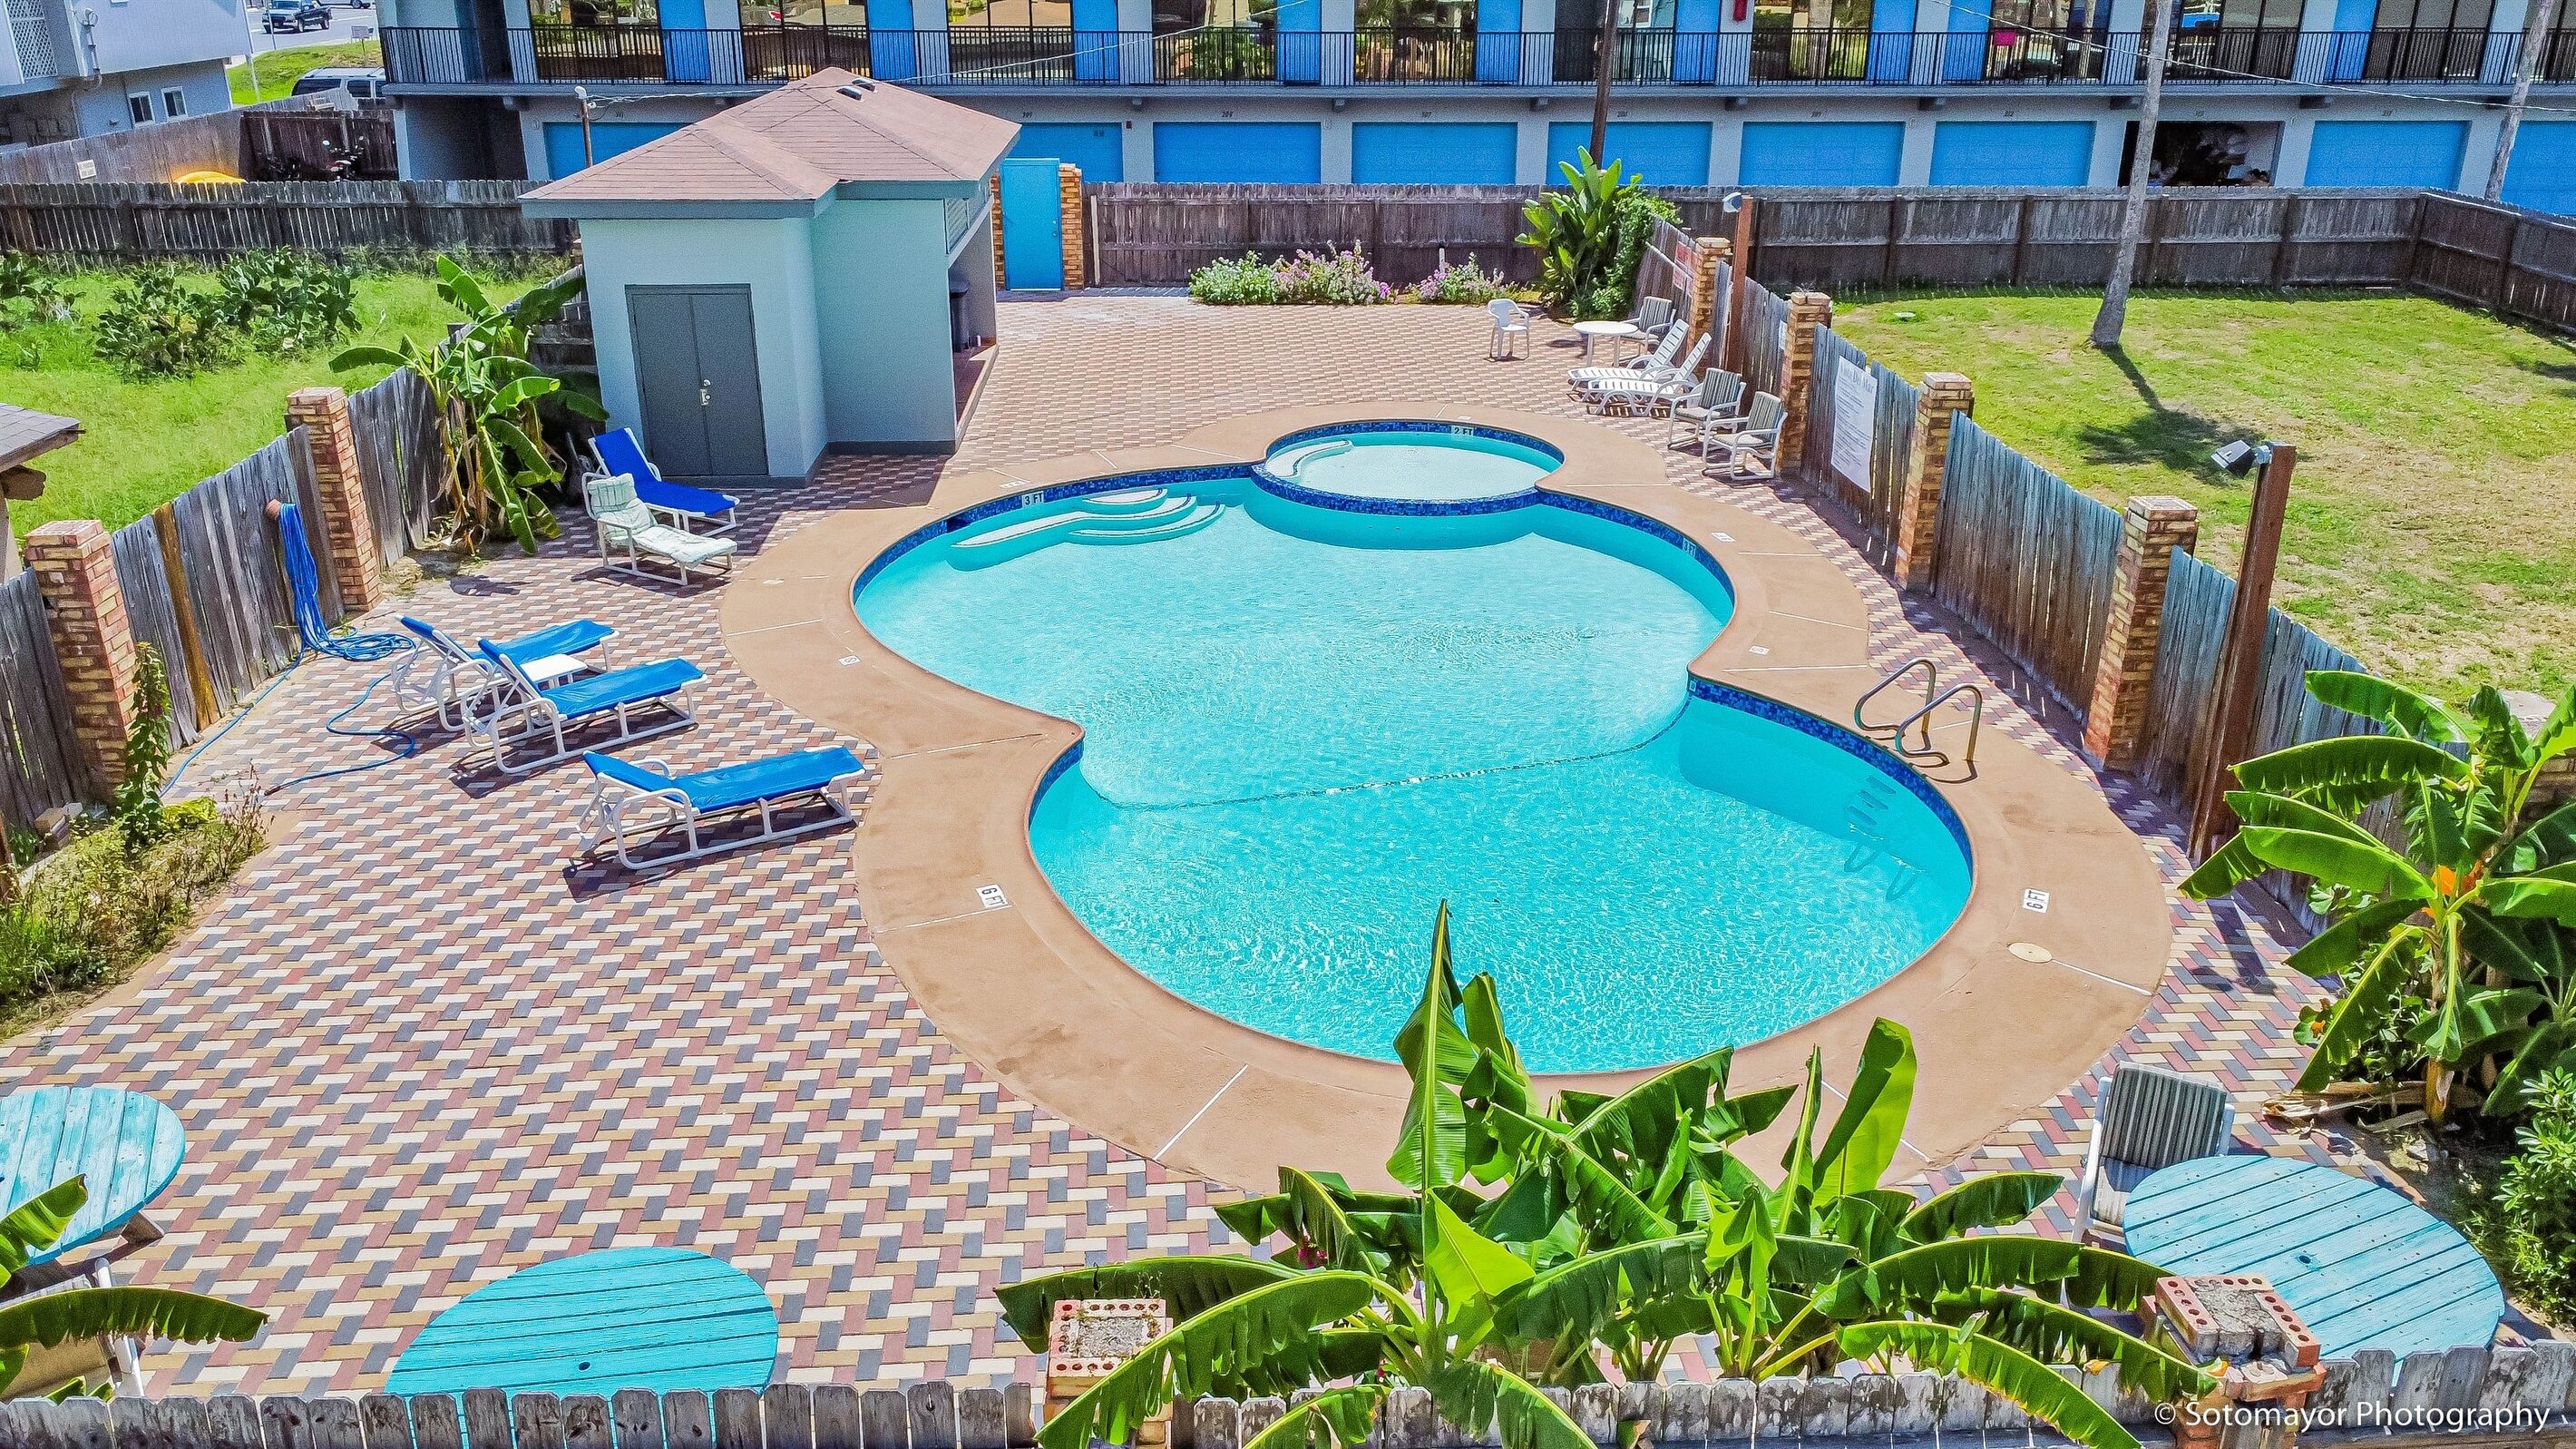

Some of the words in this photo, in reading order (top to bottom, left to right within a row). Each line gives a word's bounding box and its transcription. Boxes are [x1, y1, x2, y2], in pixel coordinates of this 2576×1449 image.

[1025, 495, 1030, 505] 3
[1034, 492, 1043, 504] FT
[985, 895, 1005, 906] FT
[2027, 890, 2045, 902] FT
